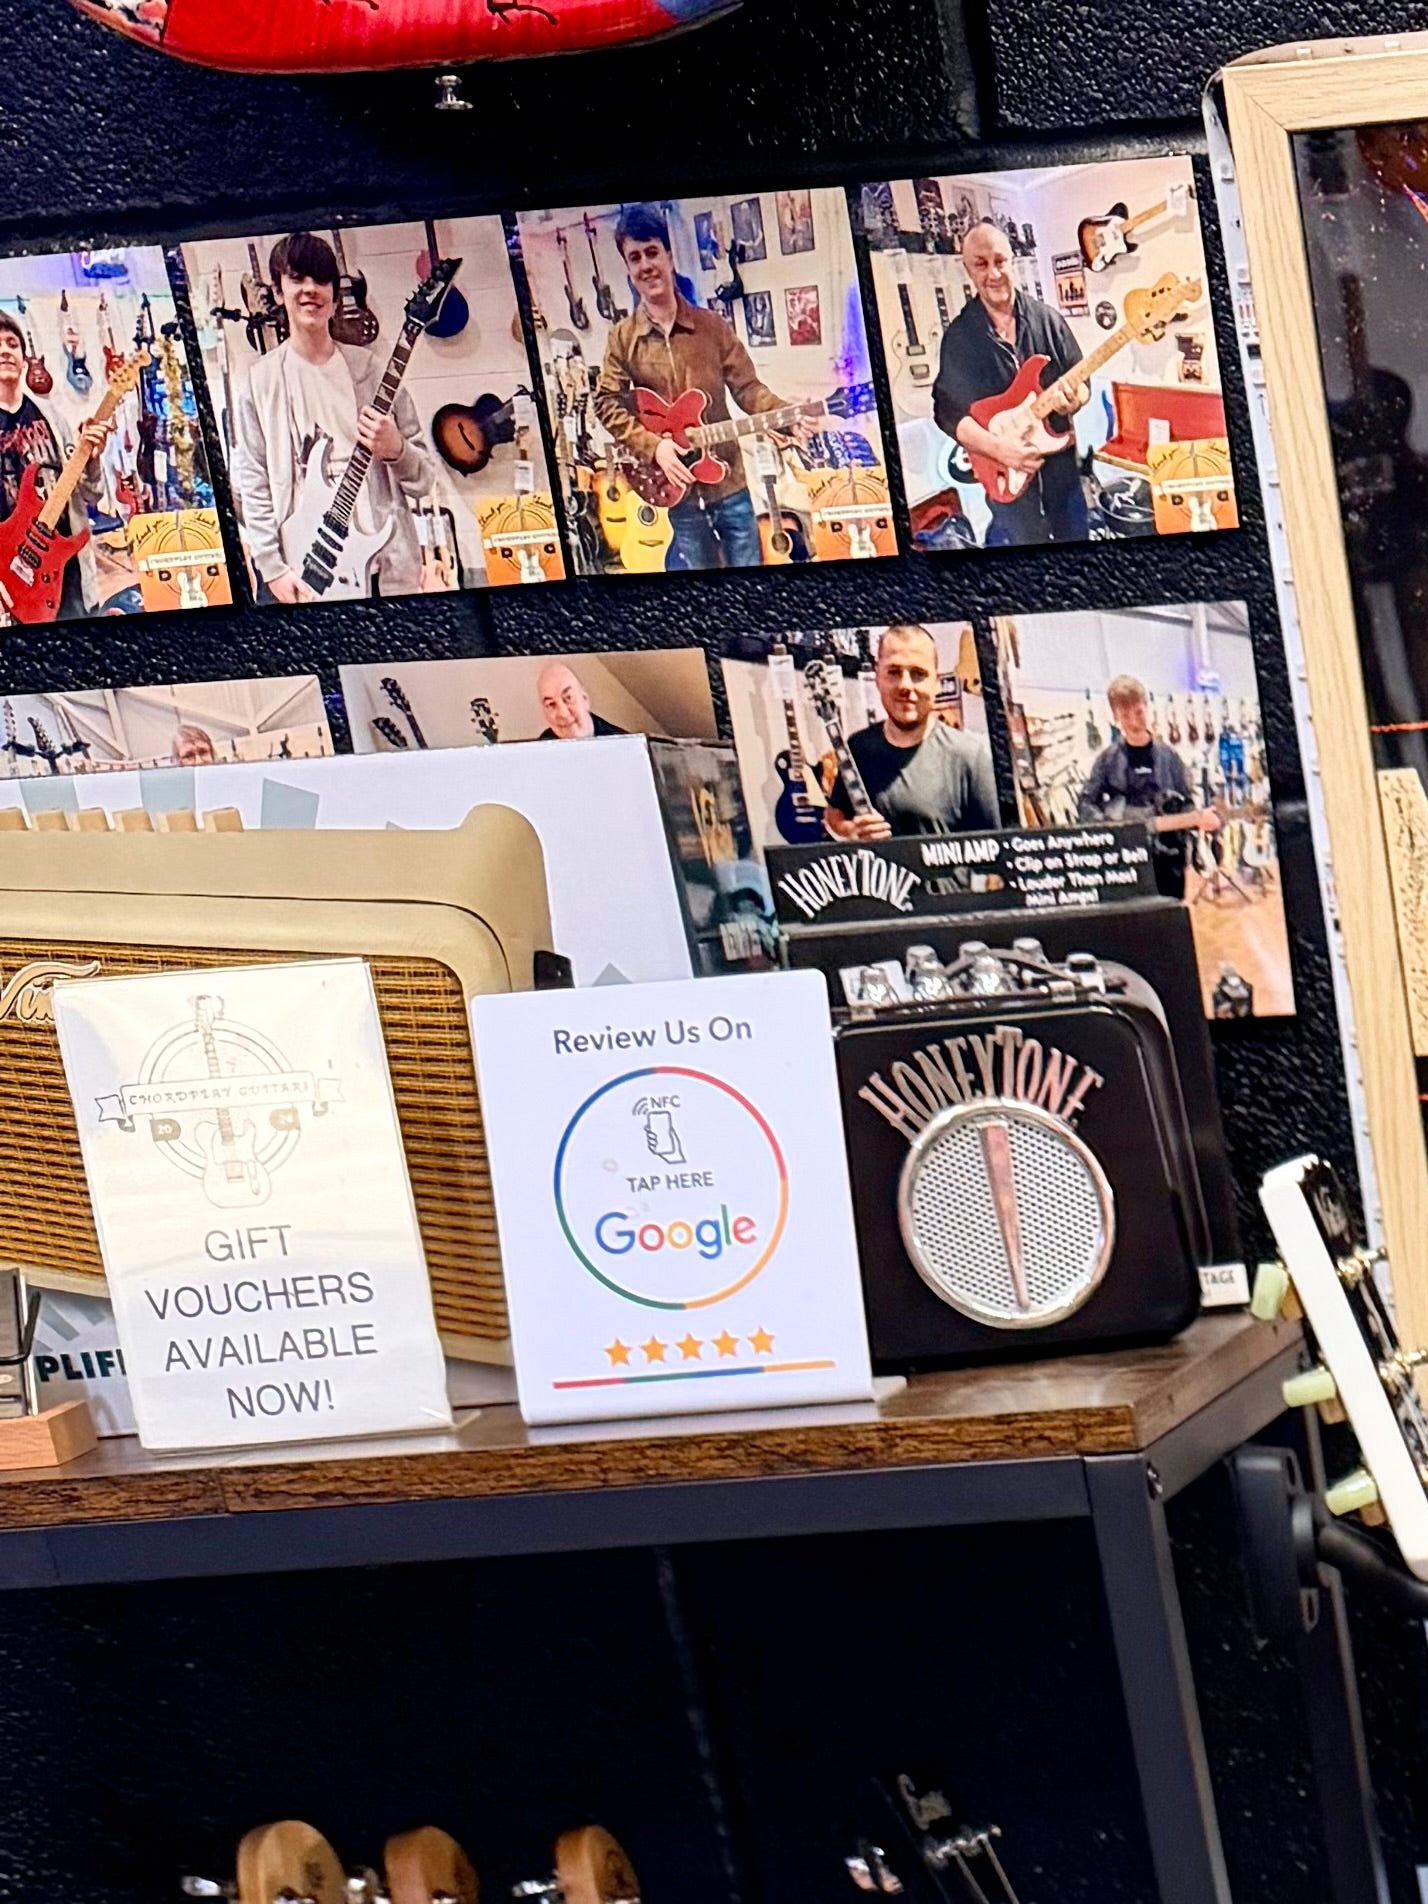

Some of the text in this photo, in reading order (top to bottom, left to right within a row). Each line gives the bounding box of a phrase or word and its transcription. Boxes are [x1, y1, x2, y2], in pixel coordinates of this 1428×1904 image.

[778, 838, 1001, 921] HONEYTONE MINI AMP
[553, 1015, 753, 1054] Review Us On
[129, 1086, 232, 1106] CHORDPLAY
[650, 1095, 681, 1109] NFC
[858, 1025, 1106, 1150] HONEYTONE
[626, 1171, 715, 1193] TAP HERE
[204, 1225, 292, 1263] GIFT
[595, 1203, 758, 1261] Google
[144, 1271, 375, 1322] VOUCHERS
[163, 1324, 379, 1373] AVAILABLE
[226, 1378, 335, 1420] NOW!
